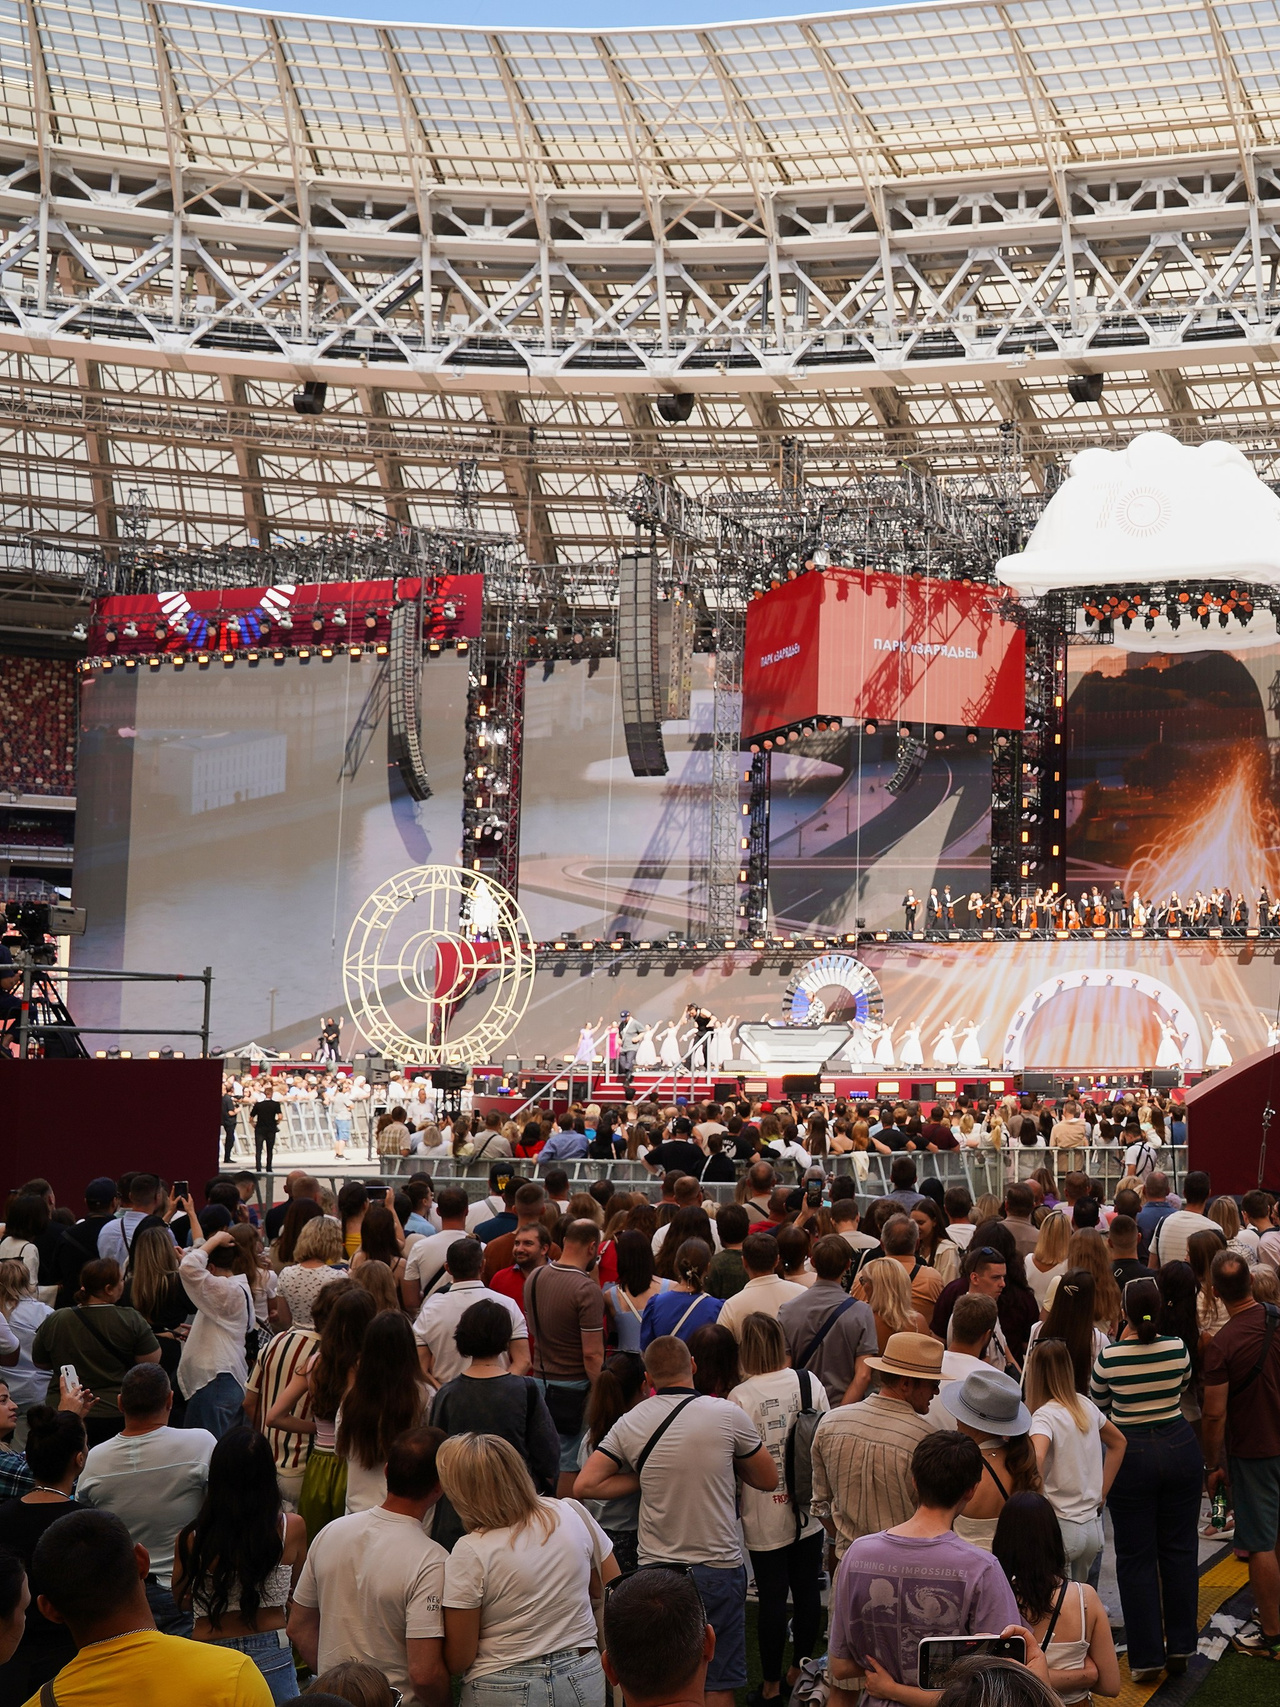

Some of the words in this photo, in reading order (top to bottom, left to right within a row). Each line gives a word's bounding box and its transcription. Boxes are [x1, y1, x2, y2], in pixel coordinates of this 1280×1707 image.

[873, 638, 907, 653] ПАРК
[910, 643, 978, 659] «ЗАРЯДЬЕ»
[849, 1560, 885, 1572] NOTHING
[887, 1563, 898, 1573] IS
[901, 1566, 968, 1578] IMPOSSIBLE!
